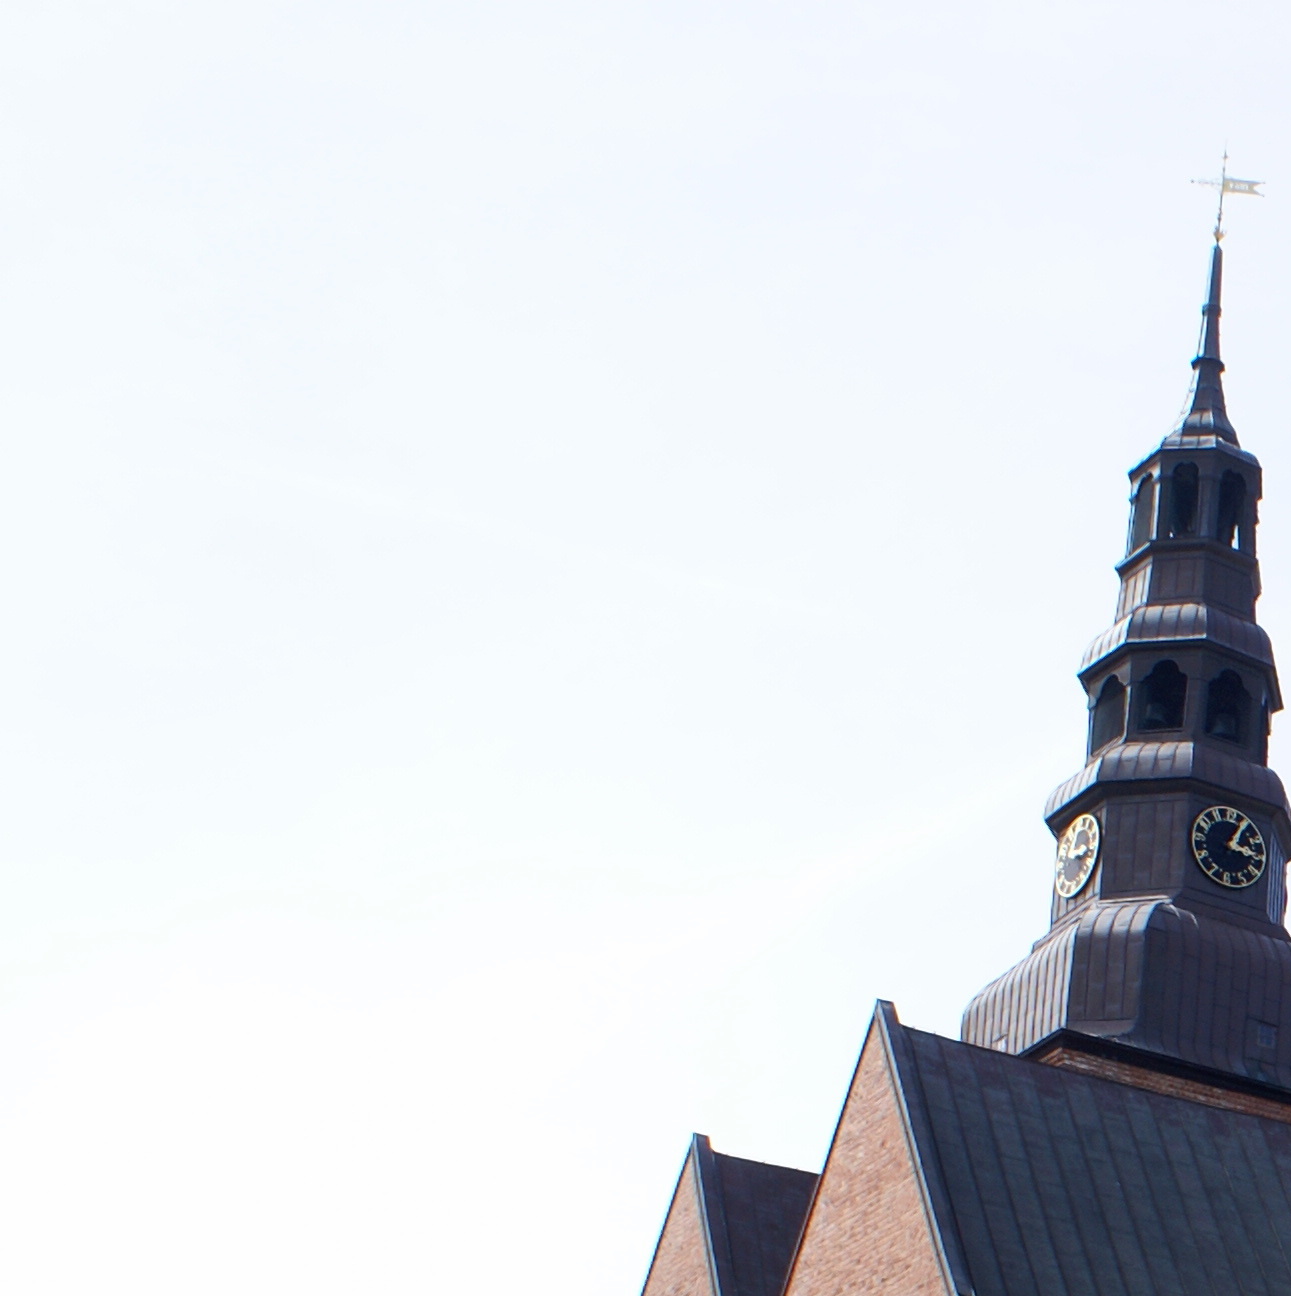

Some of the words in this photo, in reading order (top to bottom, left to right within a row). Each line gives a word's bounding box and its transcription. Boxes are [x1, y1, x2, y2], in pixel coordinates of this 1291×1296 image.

[1194, 832, 1206, 841] 9
[1248, 834, 1261, 845] 2
[1208, 862, 1219, 875] 7
[1248, 864, 1261, 876] 4
[1223, 871, 1231, 885] 6
[1237, 871, 1247, 885] 5
